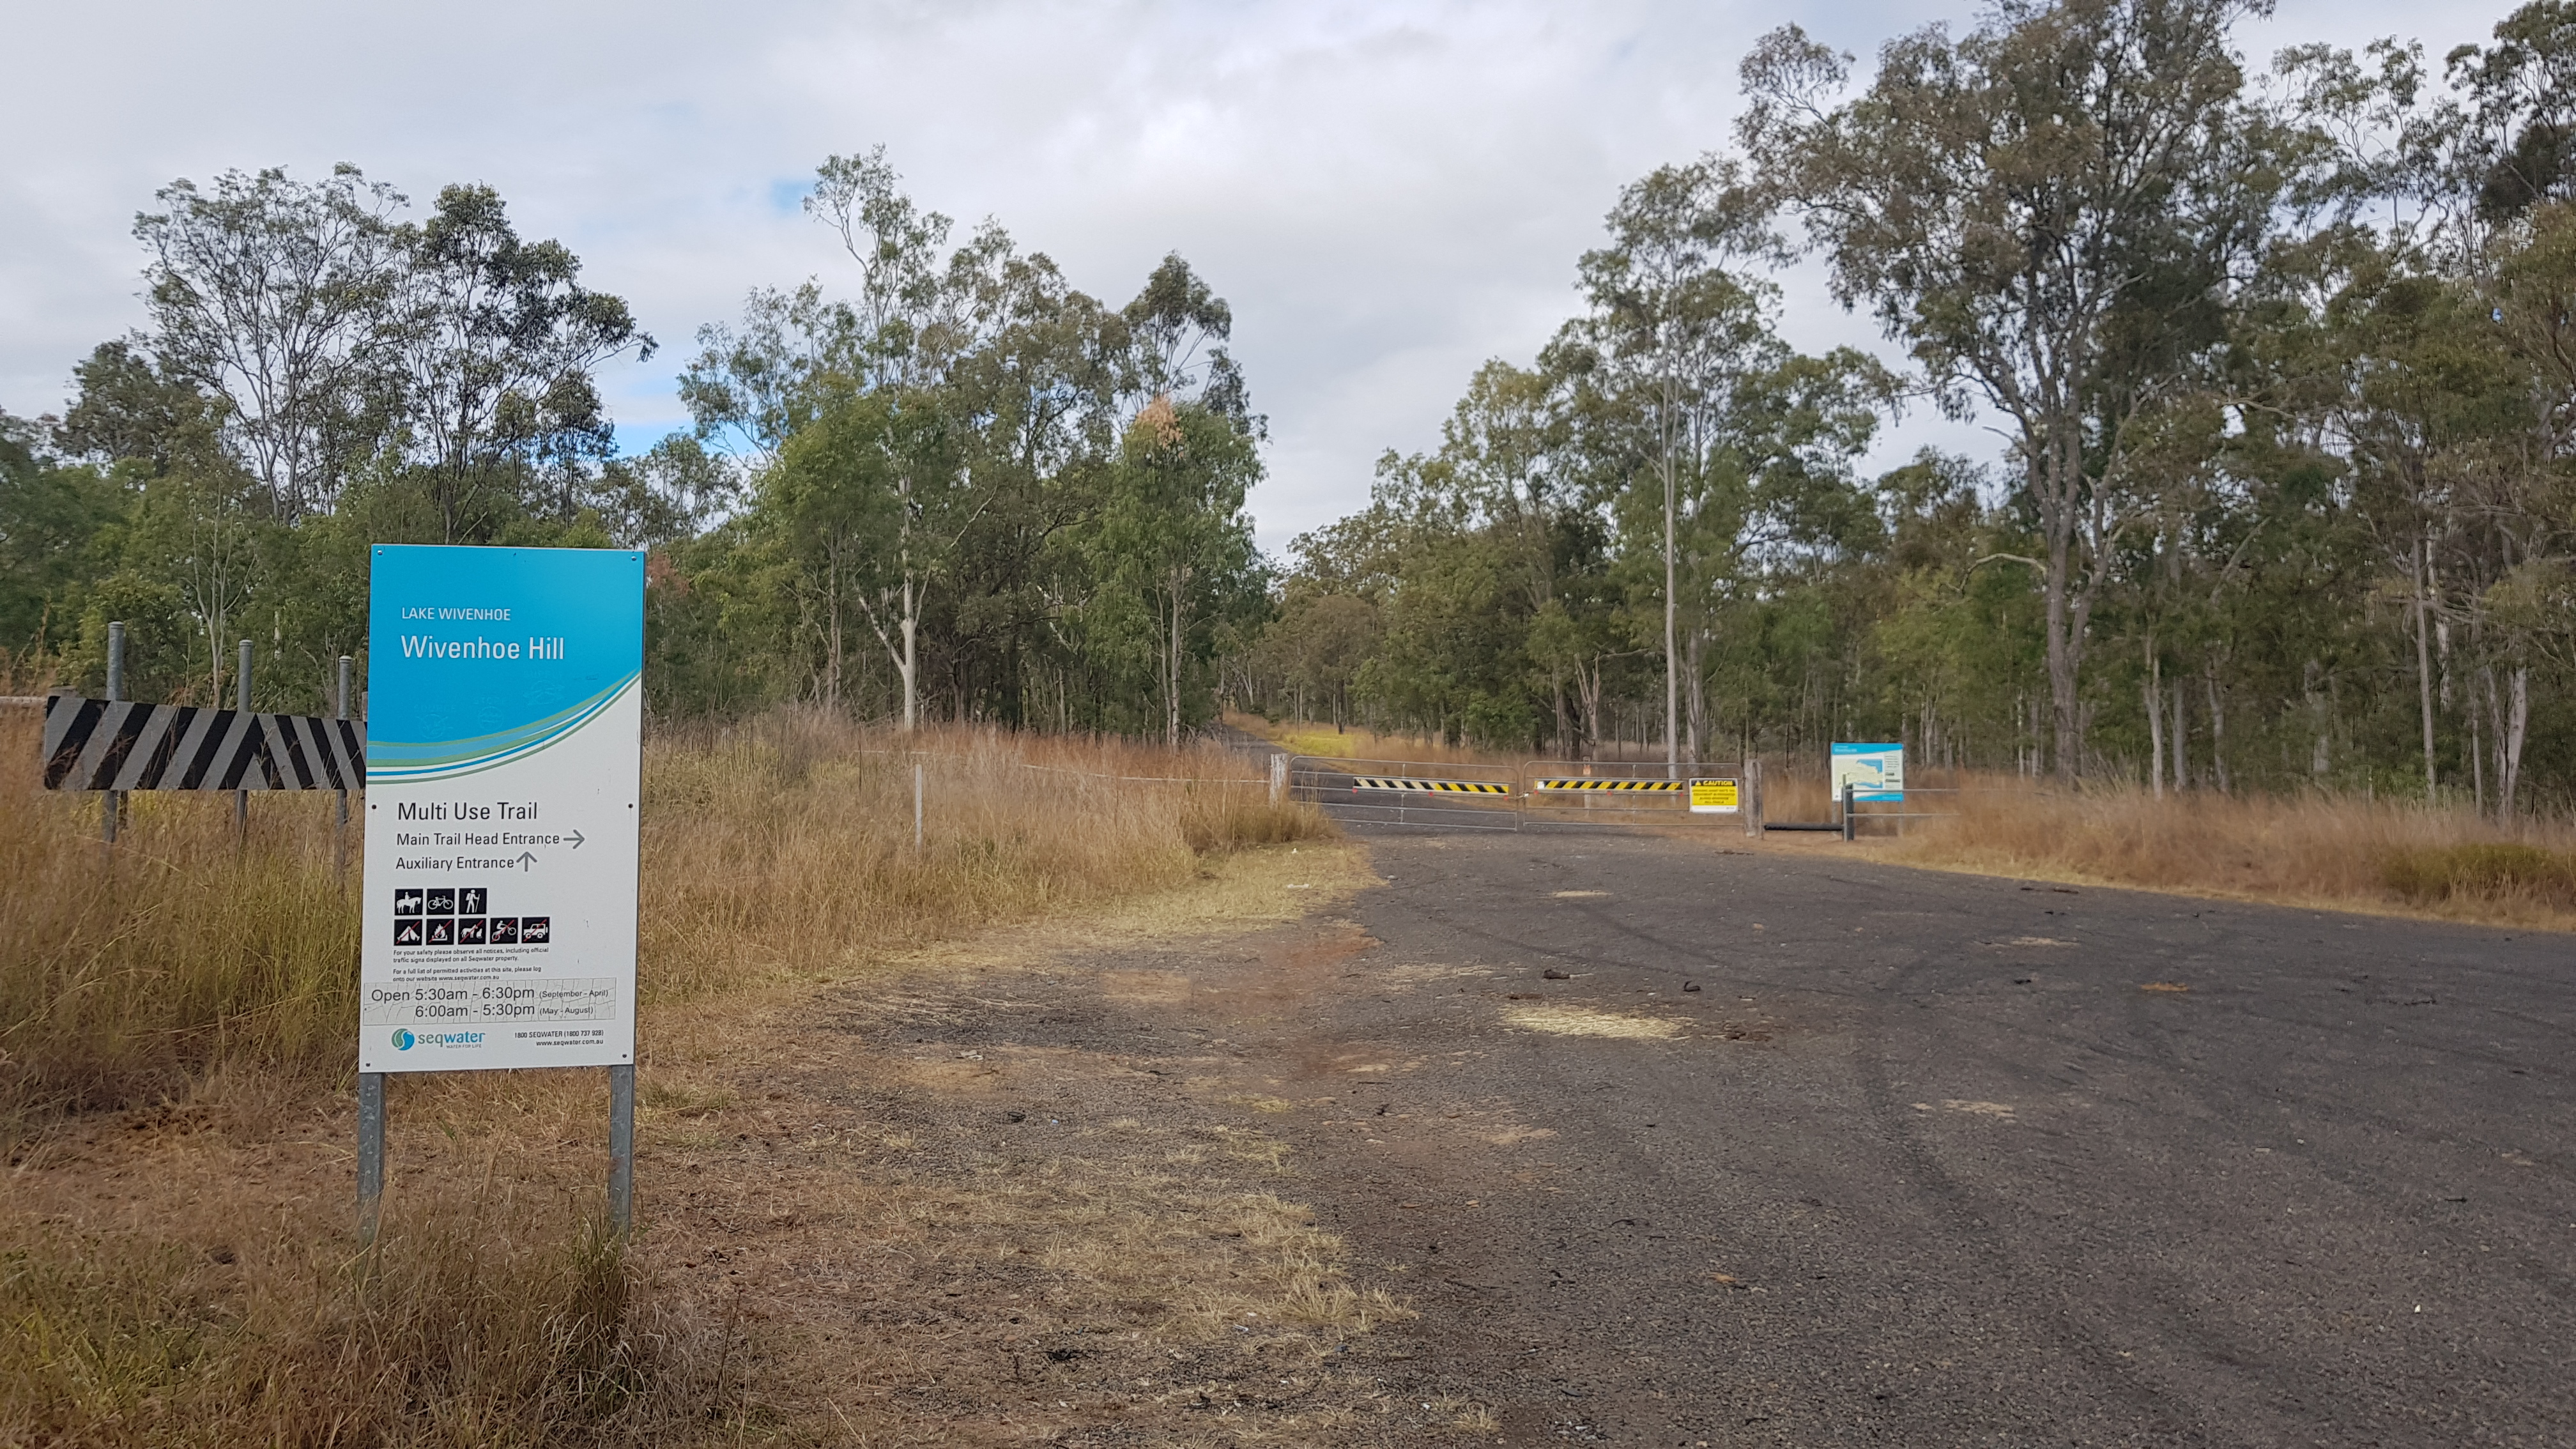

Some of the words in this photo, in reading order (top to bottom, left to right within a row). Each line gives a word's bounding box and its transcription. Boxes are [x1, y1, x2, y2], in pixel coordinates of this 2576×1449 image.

[401, 607, 435, 620] LAKE
[439, 608, 511, 621] WIVENHOE
[401, 635, 521, 659] Wivenhoe
[528, 637, 565, 660] Hill
[397, 802, 447, 821] Multi
[454, 802, 491, 821] Use
[497, 802, 538, 820] Trail
[397, 833, 429, 846] Main
[434, 832, 461, 845] Trail
[465, 832, 498, 845] Head
[503, 832, 560, 845] Entrance
[395, 857, 452, 872] Auxiliary
[457, 856, 514, 870] Entrance
[371, 989, 410, 1004] Open
[415, 988, 468, 1000] 5:30am
[482, 987, 535, 1001] 6:30pm
[539, 990, 582, 999] (September
[589, 990, 608, 998] April)
[415, 1005, 468, 1018] 6:00am
[483, 1004, 535, 1018] 5:30pm
[565, 1006, 594, 1015] August)
[418, 1031, 486, 1048] seqwater
